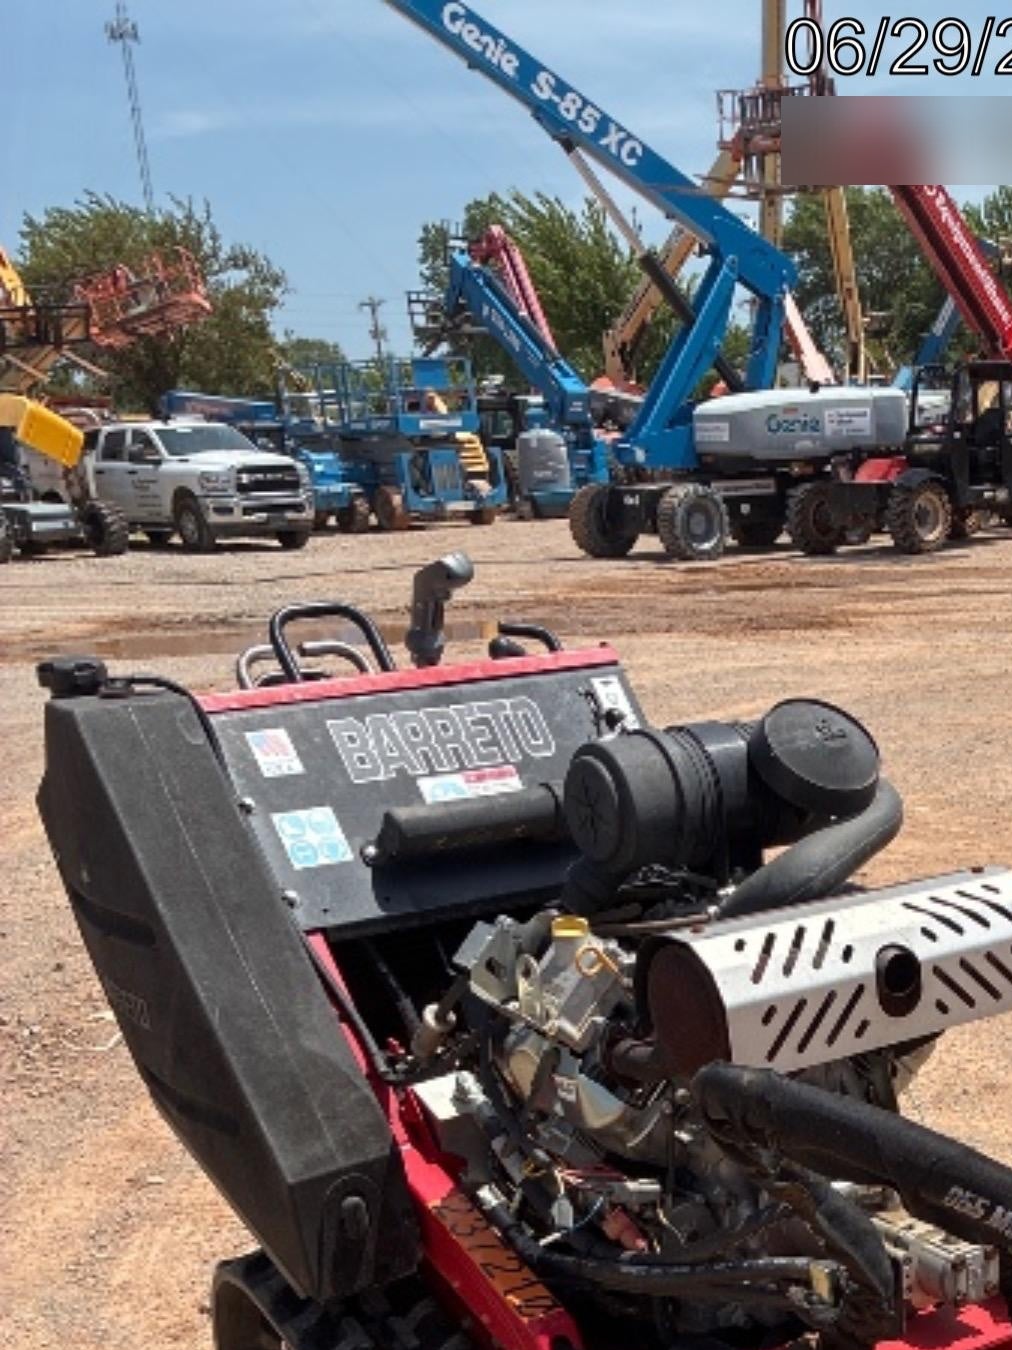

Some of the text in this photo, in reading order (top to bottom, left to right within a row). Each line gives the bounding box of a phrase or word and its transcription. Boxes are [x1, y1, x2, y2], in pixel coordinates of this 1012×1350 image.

[441, 2, 643, 166] Genie S-85 XC
[766, 413, 821, 434] Genie
[326, 697, 556, 784] BARRETO
